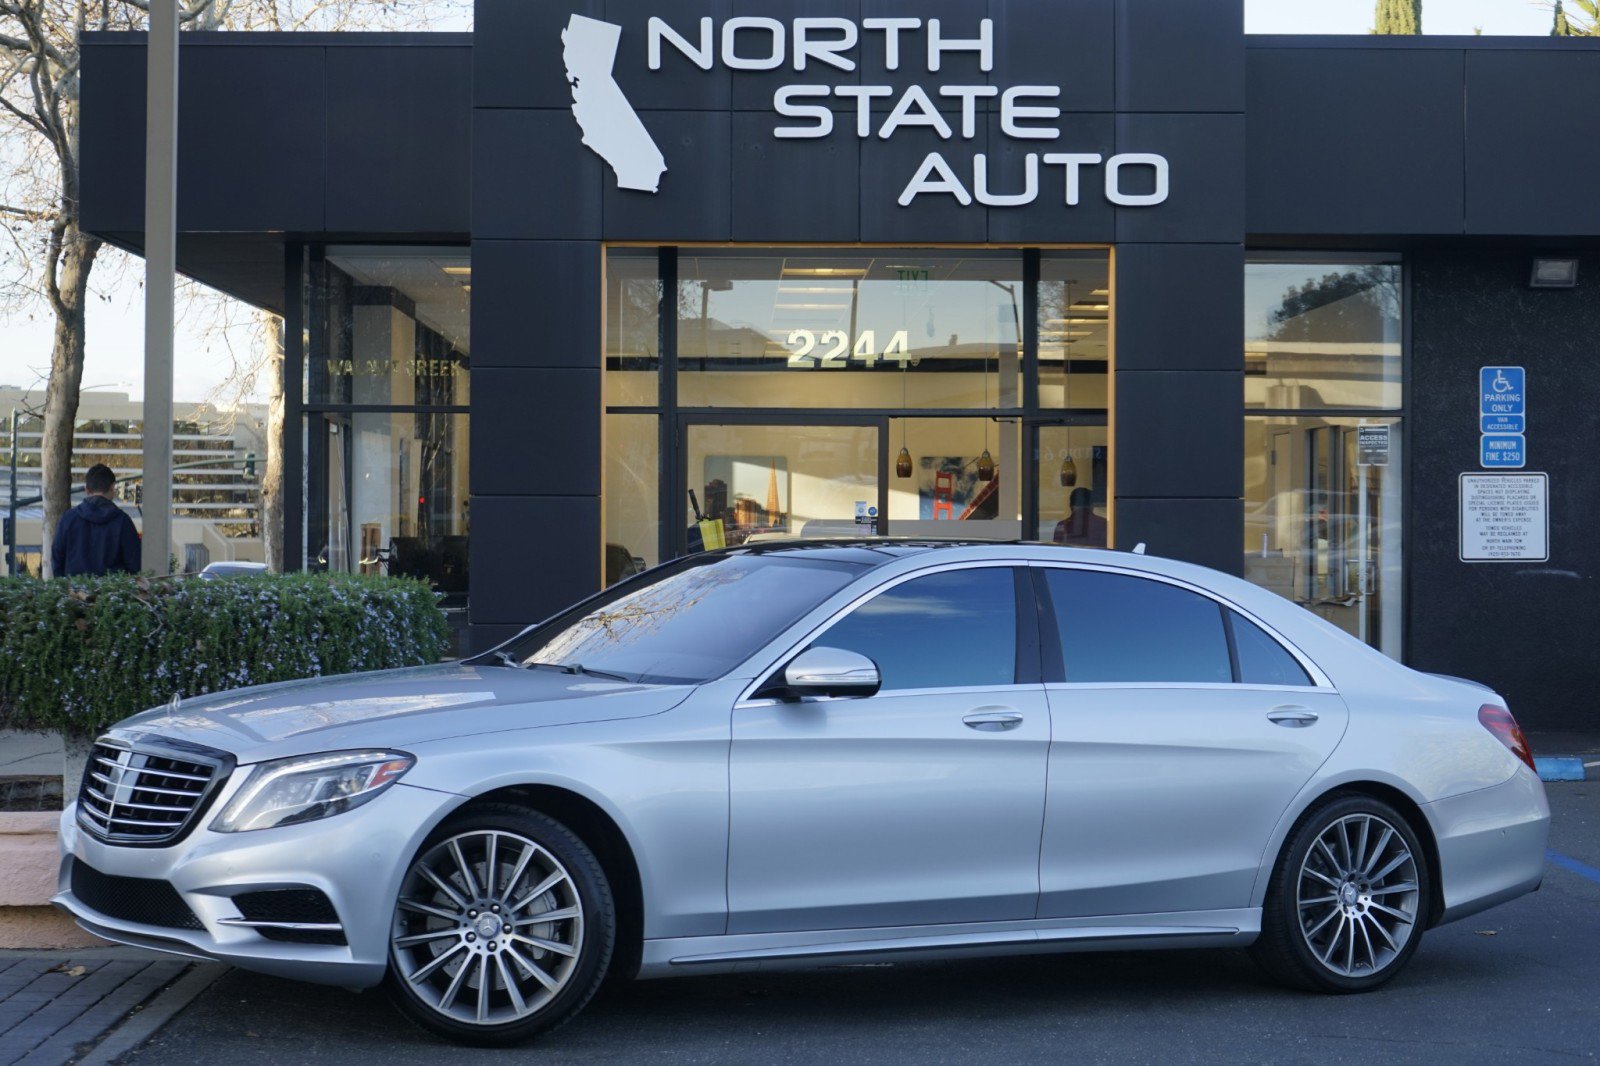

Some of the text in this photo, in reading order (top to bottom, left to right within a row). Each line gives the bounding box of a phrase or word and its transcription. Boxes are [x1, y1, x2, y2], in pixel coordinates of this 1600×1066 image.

[647, 16, 994, 72] NORTH
[774, 84, 1061, 139] STATE
[897, 152, 1170, 207] AUTO
[787, 329, 911, 368] 2244
[406, 360, 461, 376] CREEK
[1492, 404, 1513, 412] ONLY
[1486, 452, 1520, 461] FINE $250
[1489, 441, 1516, 450] MINIMUM
